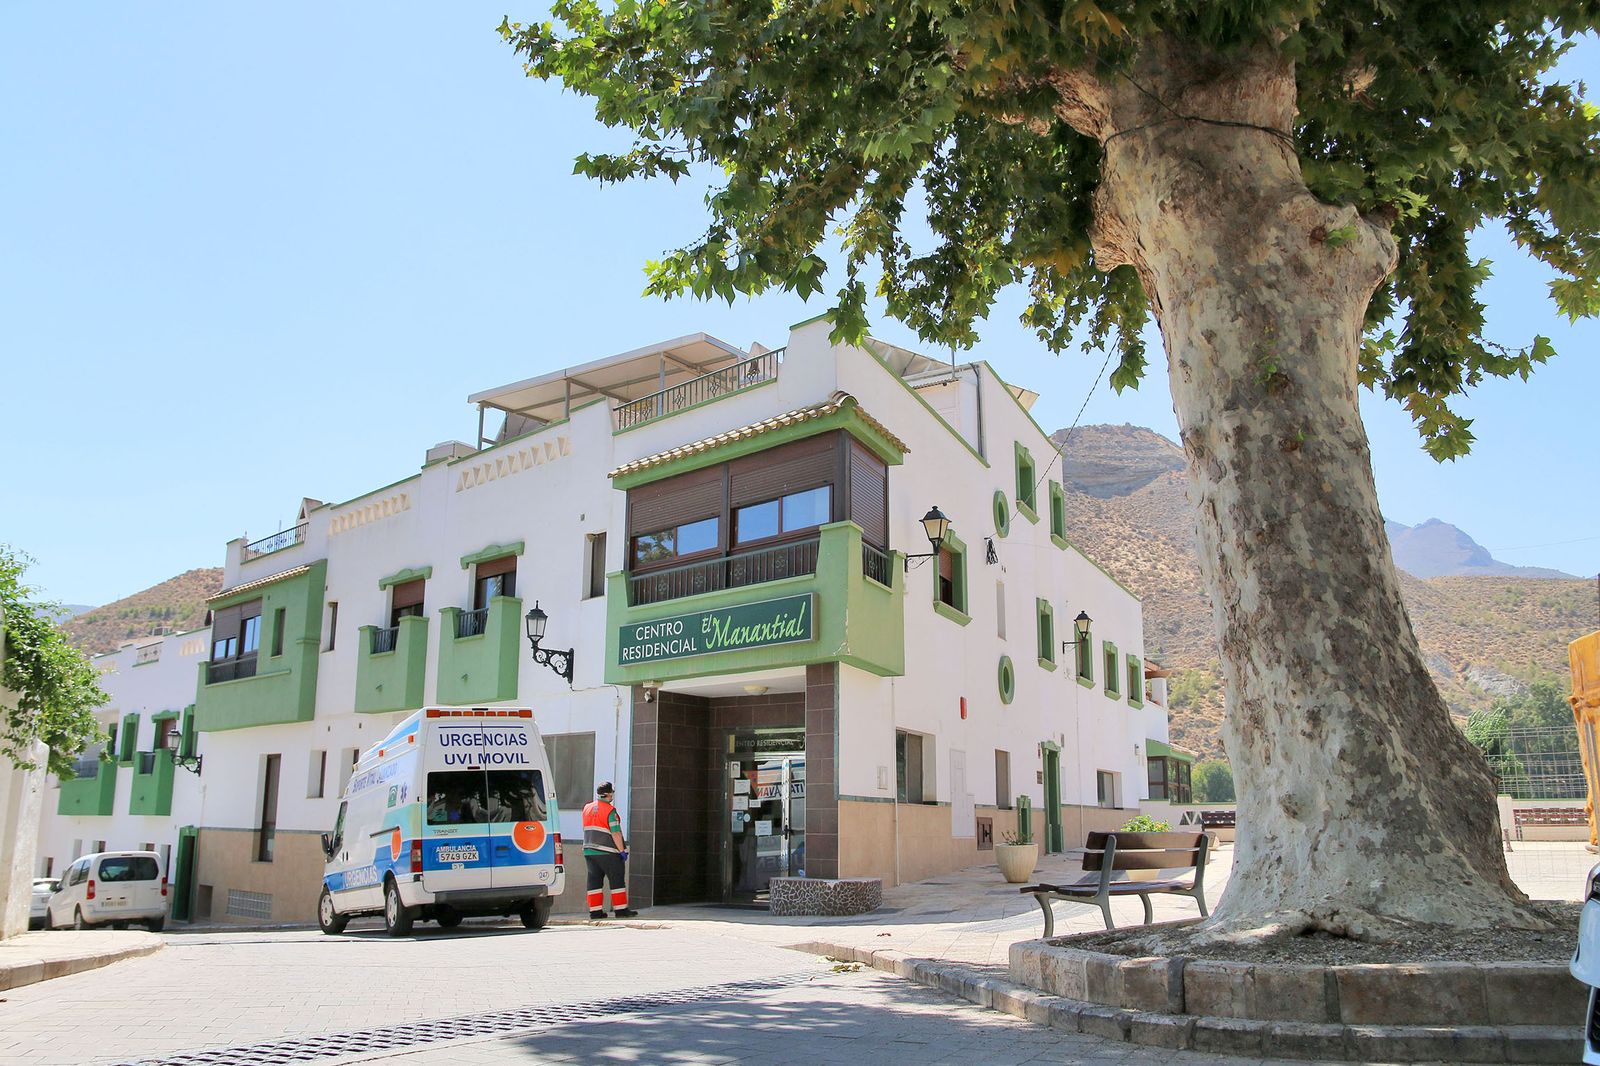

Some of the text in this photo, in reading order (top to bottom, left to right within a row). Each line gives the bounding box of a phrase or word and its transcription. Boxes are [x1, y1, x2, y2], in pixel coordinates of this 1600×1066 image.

[635, 620, 684, 641] CENTRO
[705, 601, 807, 649] Manantial
[622, 637, 698, 661] RESIDENCIAL
[440, 733, 528, 747] URGENCIAS
[444, 752, 530, 765] UVI MOVIL
[436, 844, 476, 852] AMBULANCIA
[440, 852, 478, 861] 5749 GZK
[344, 865, 378, 889] URGENCIAS
